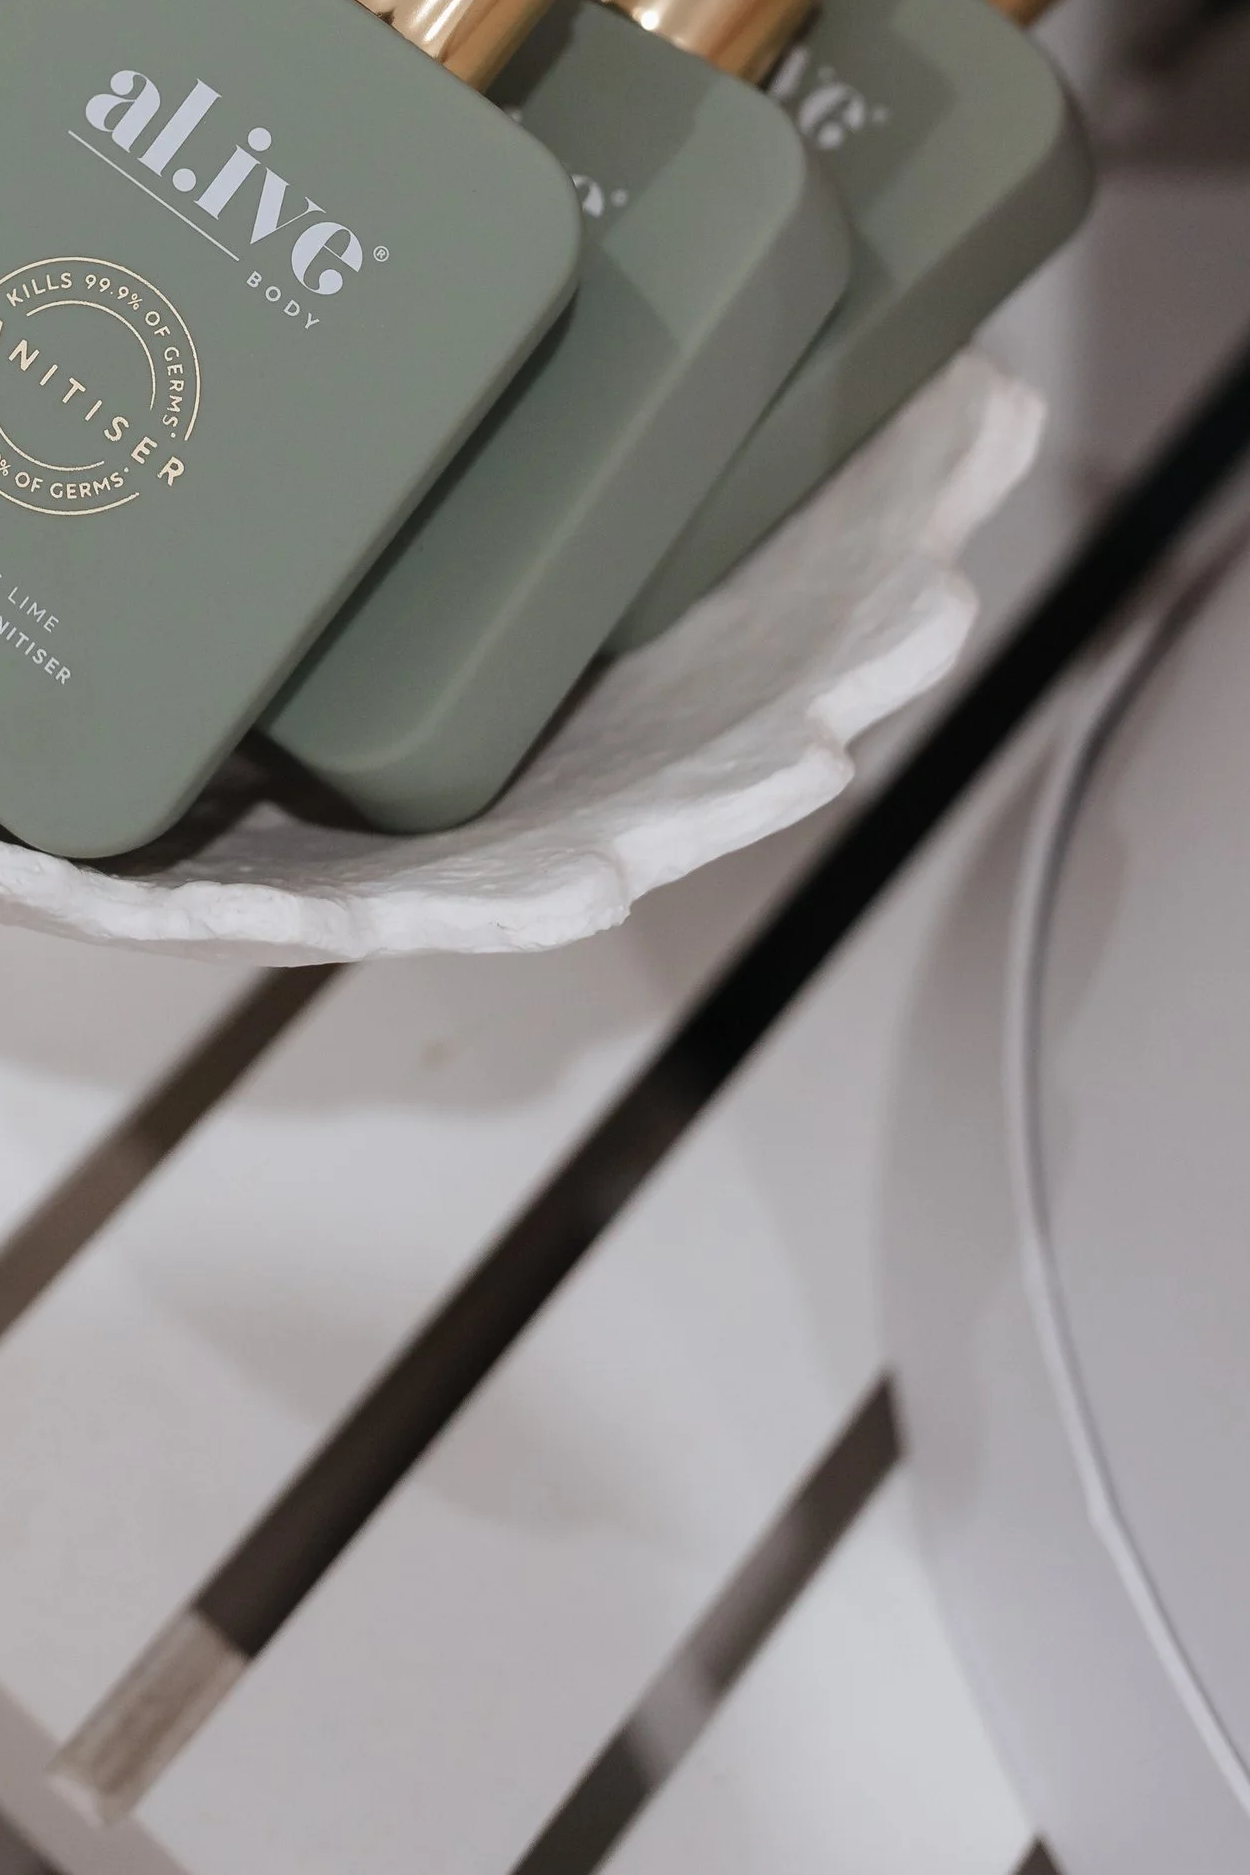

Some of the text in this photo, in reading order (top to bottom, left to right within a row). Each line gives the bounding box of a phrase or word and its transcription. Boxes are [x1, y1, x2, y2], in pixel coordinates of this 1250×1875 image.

[6, 273, 73, 307] KILLS
[85, 275, 143, 311] 99.9%
[145, 311, 171, 338] OF
[246, 271, 320, 329] BODY
[14, 471, 44, 493] OF
[7, 586, 60, 634] LIME
